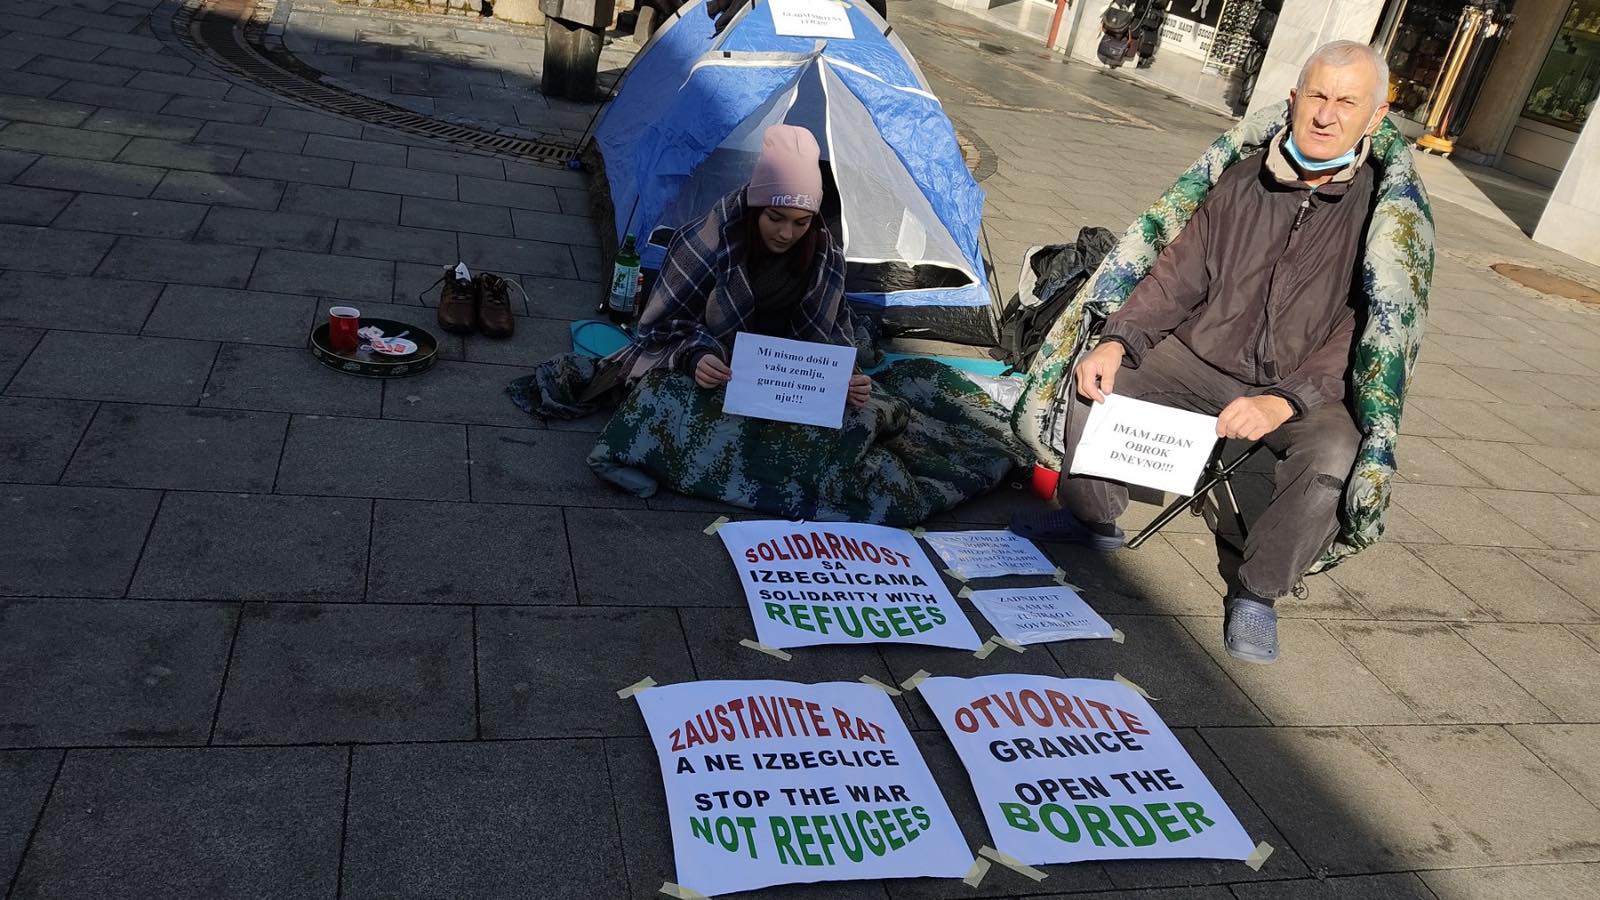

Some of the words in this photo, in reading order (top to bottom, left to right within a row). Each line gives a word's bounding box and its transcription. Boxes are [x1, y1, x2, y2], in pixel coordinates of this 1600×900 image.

[758, 346, 772, 356] Mi
[774, 351, 804, 362] nismo
[806, 354, 830, 366] došli
[764, 362, 787, 373] vašu
[789, 368, 825, 380] zemlju,
[757, 377, 795, 389] gurnuti
[797, 383, 817, 391] smo
[819, 386, 826, 394] u
[775, 392, 803, 404] nju!!!
[1113, 423, 1150, 440] IMAM
[1152, 433, 1194, 448] JEDAN
[1109, 450, 1174, 472] DNEVNO!!!
[1125, 440, 1171, 458] OBROK
[745, 532, 910, 568] SOLIDARNOST
[822, 560, 847, 570] SA
[750, 570, 928, 587] IZBEGLICAMA
[759, 589, 878, 602] SOLIDARITY
[884, 592, 938, 604] WITH
[764, 602, 947, 639] REFUGEES
[669, 696, 831, 752] ZAUSTAVITE
[832, 706, 886, 744] RAT
[955, 689, 1150, 735] OTVORITE
[989, 730, 1144, 763] GRANICE
[676, 756, 696, 774] A
[704, 754, 744, 772] NE
[753, 750, 899, 770] IZBEGLICE
[694, 789, 770, 811] STOP
[780, 786, 840, 806] THE
[845, 784, 911, 803] WAR
[1014, 776, 1110, 805] OPEN
[1110, 768, 1184, 794] THE
[690, 815, 758, 859] NOT
[769, 805, 931, 866] REFUGEES
[998, 801, 1216, 848] BORDER
